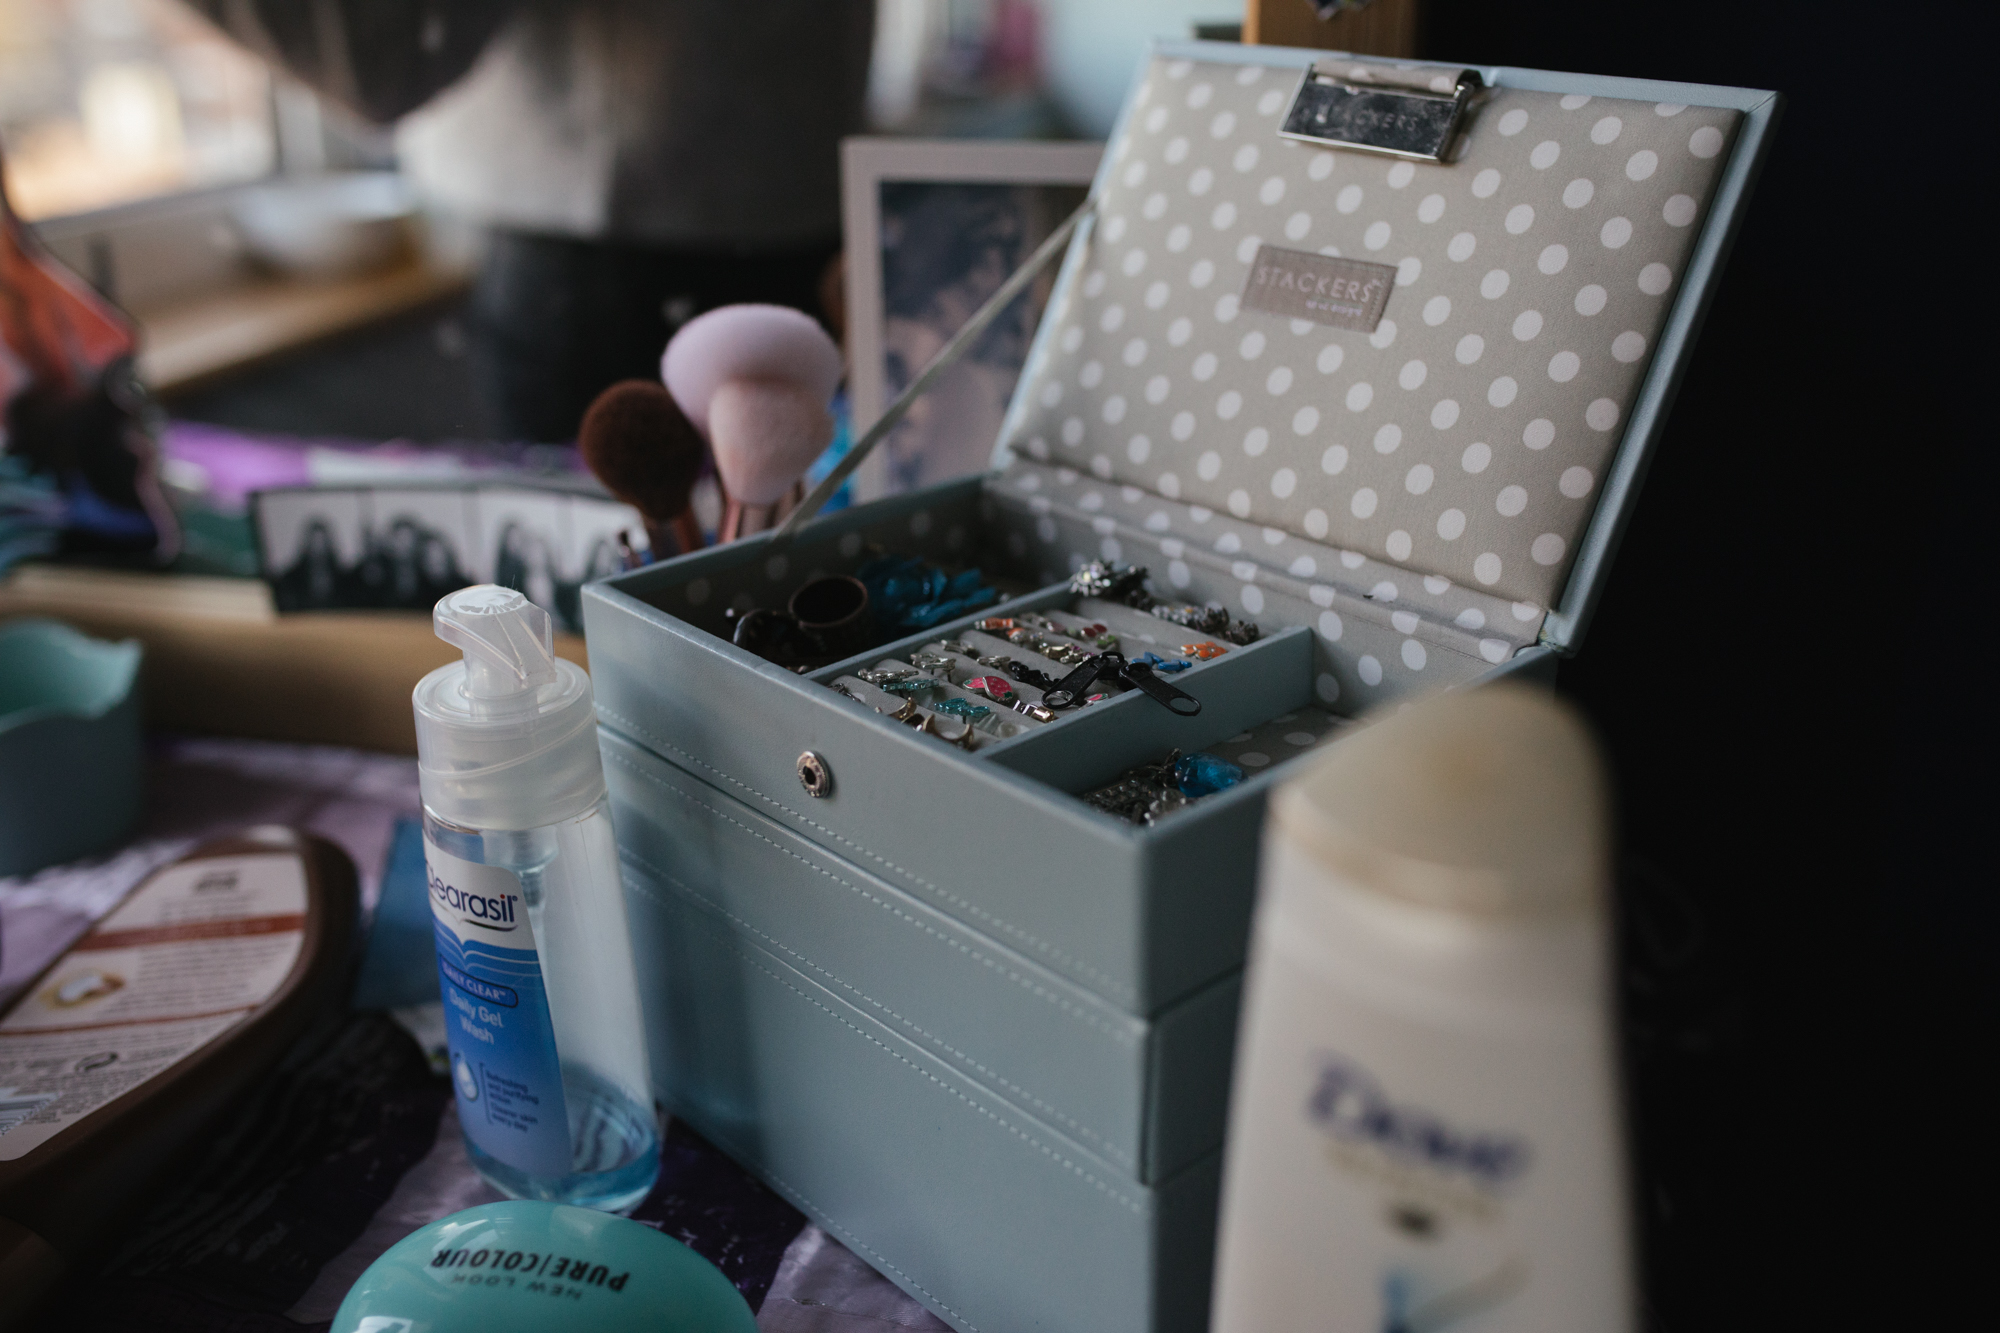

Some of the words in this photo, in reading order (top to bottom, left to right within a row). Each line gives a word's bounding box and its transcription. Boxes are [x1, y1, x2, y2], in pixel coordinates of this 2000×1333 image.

[1256, 265, 1373, 303] STACKERS
[449, 986, 476, 1020] Daily
[478, 1006, 504, 1029] Gel
[460, 1013, 495, 1045] Wash
[452, 1273, 517, 1289] LOOK
[526, 1281, 582, 1299] NEW
